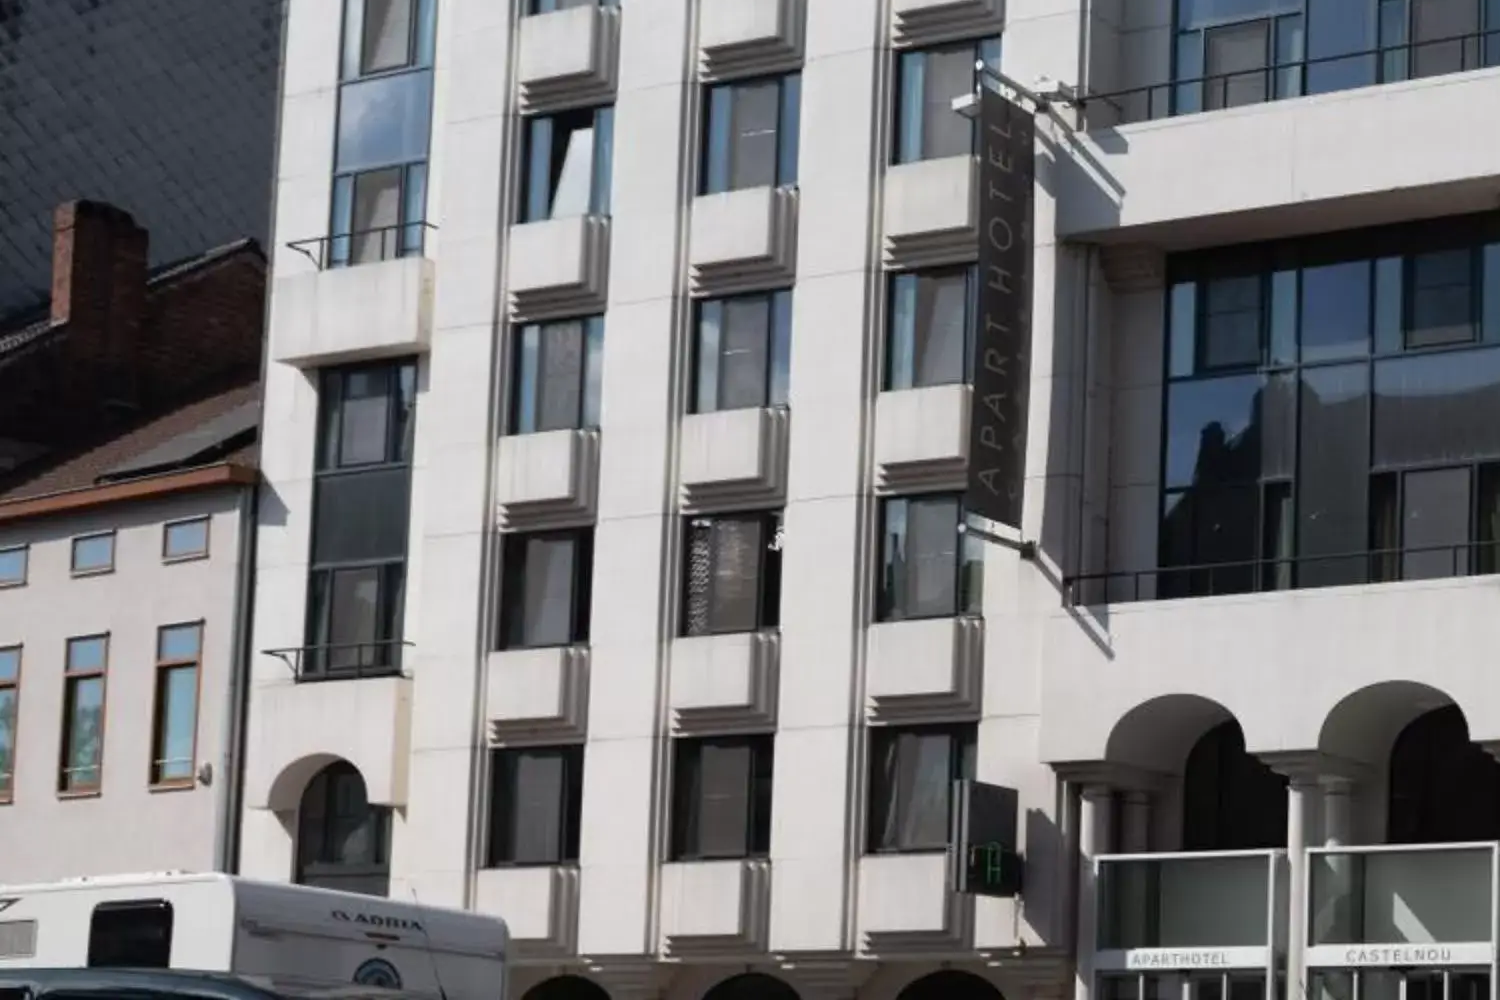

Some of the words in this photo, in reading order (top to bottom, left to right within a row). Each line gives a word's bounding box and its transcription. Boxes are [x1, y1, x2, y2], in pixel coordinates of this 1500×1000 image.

[978, 122, 1013, 496] APARTHOTEL
[1132, 952, 1228, 966] APARTHOTEL
[1345, 949, 1452, 963] CASTELNOU
